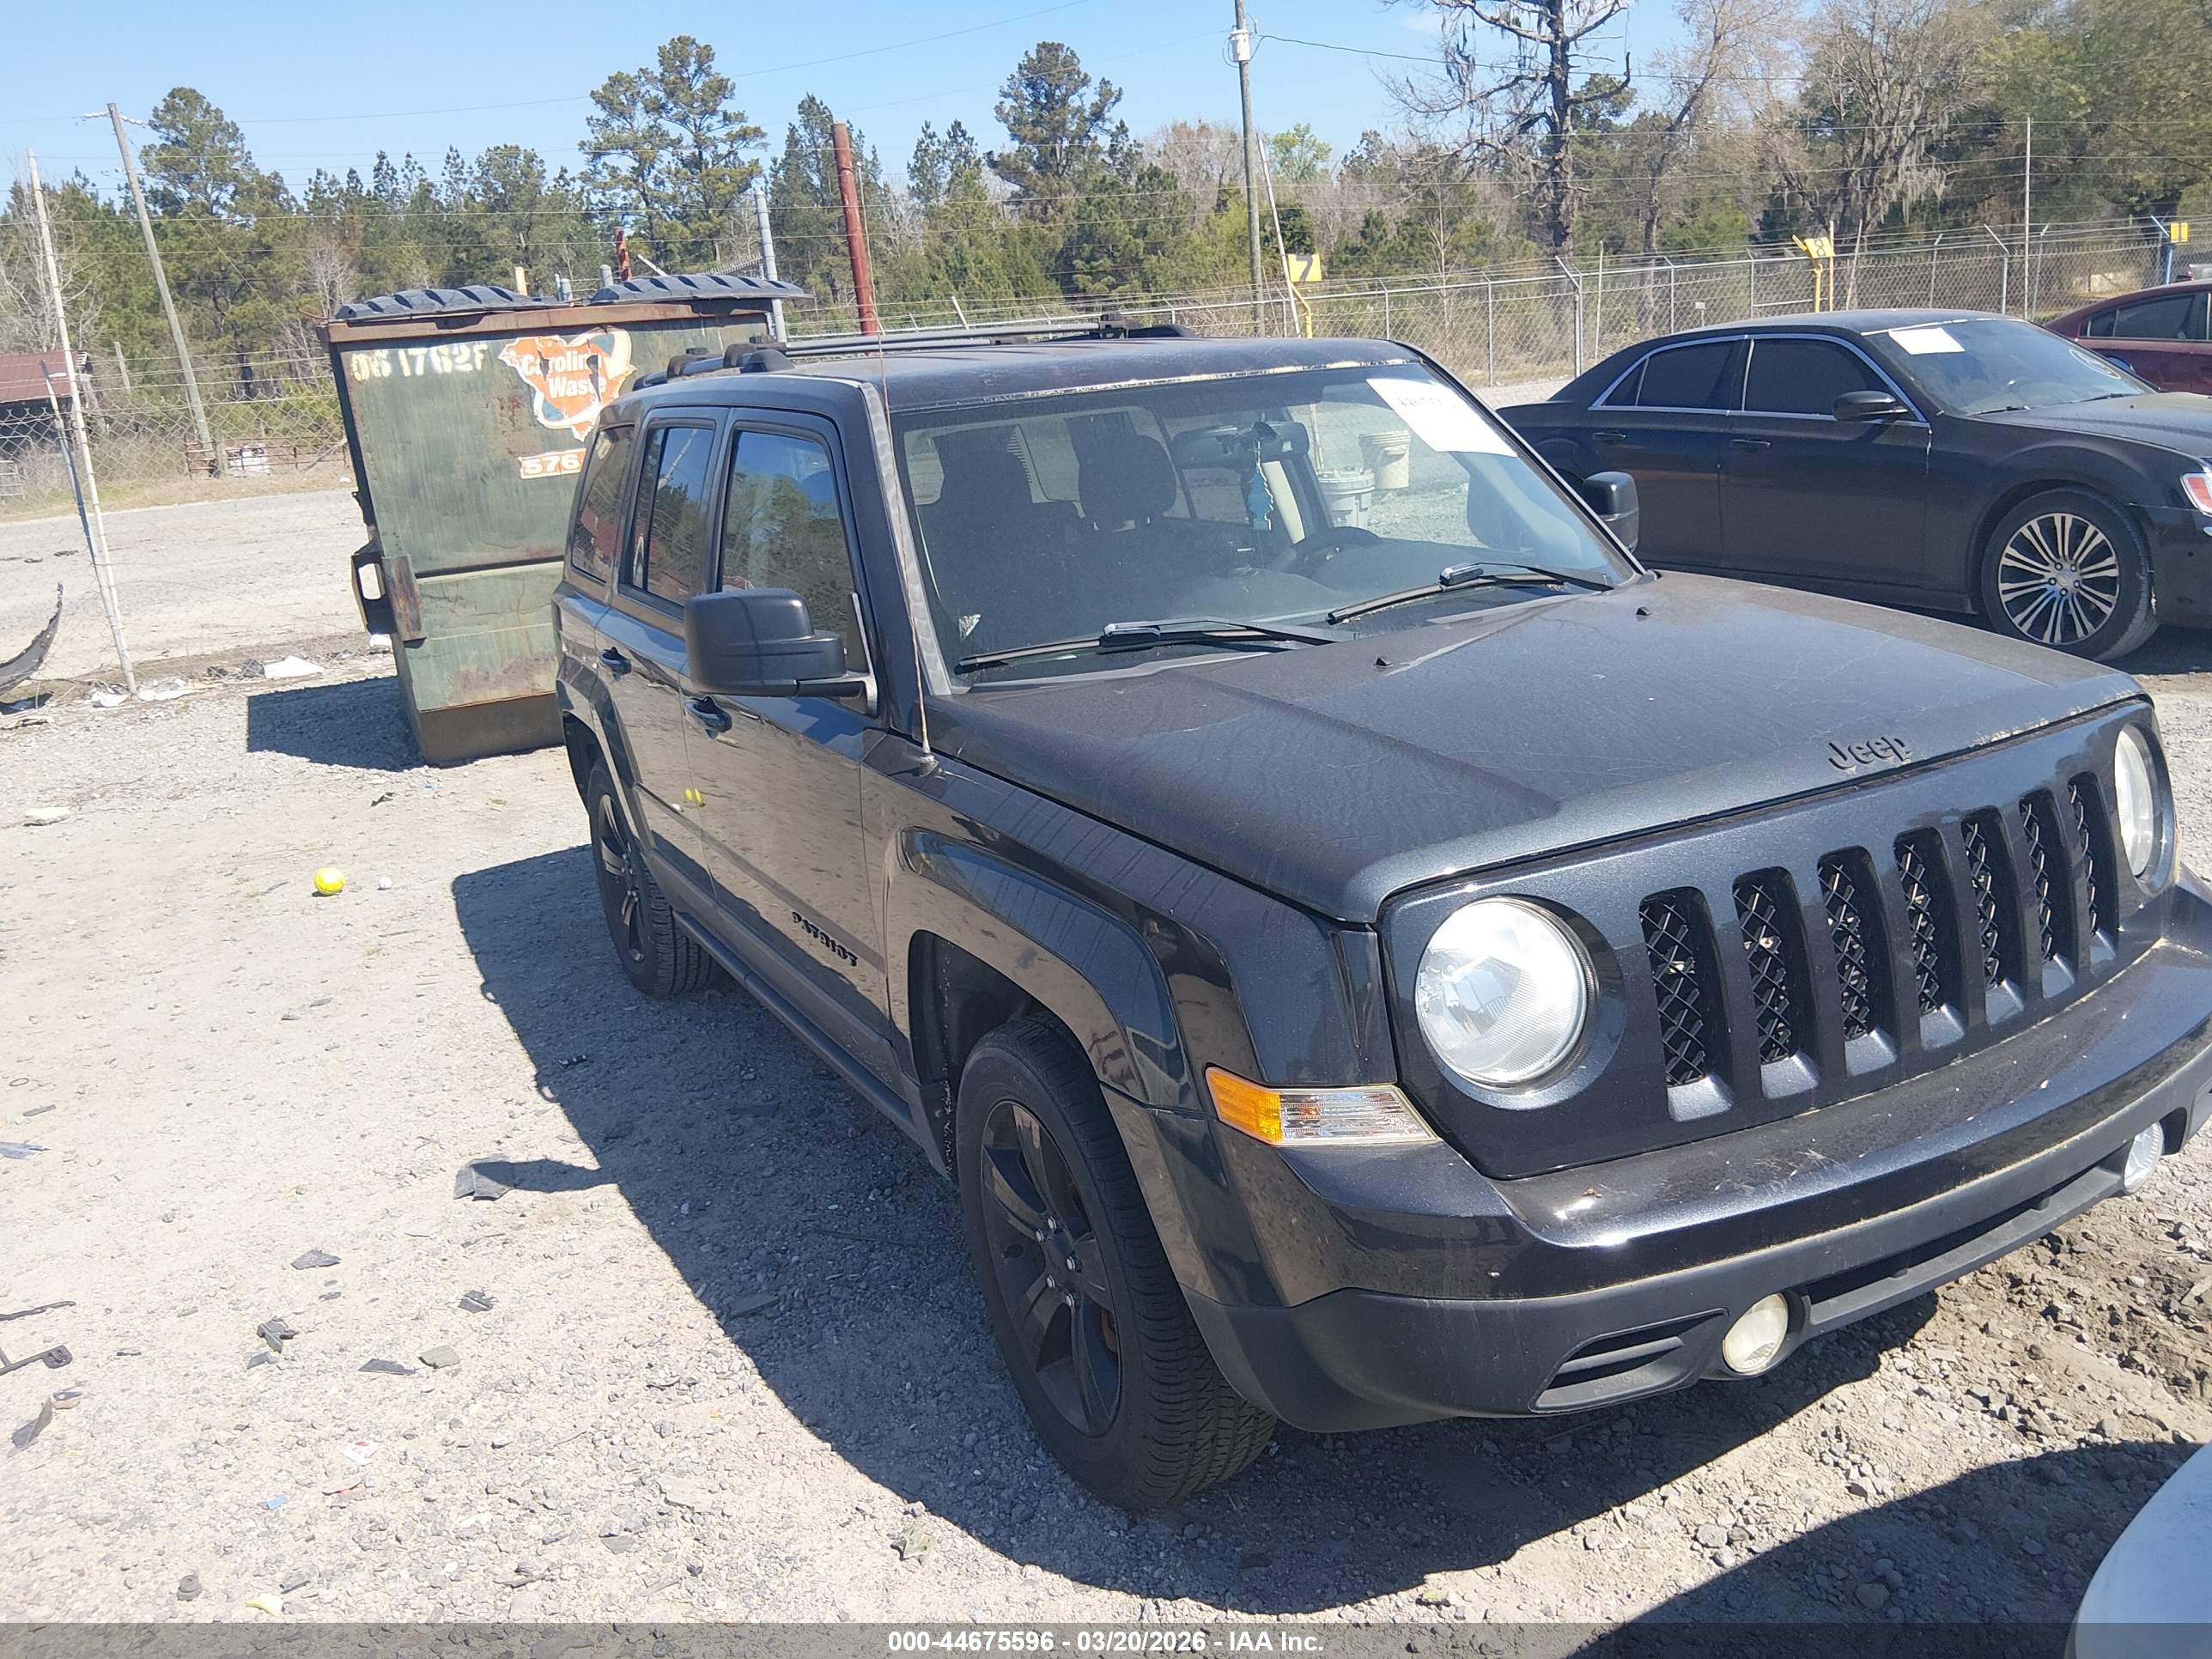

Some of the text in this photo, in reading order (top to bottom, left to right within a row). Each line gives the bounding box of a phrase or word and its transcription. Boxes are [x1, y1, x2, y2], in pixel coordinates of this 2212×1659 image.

[1814, 238, 1826, 257] 8
[1295, 253, 1314, 282] 7
[1827, 736, 1911, 771] Jeep
[792, 911, 859, 967] PATRIOT
